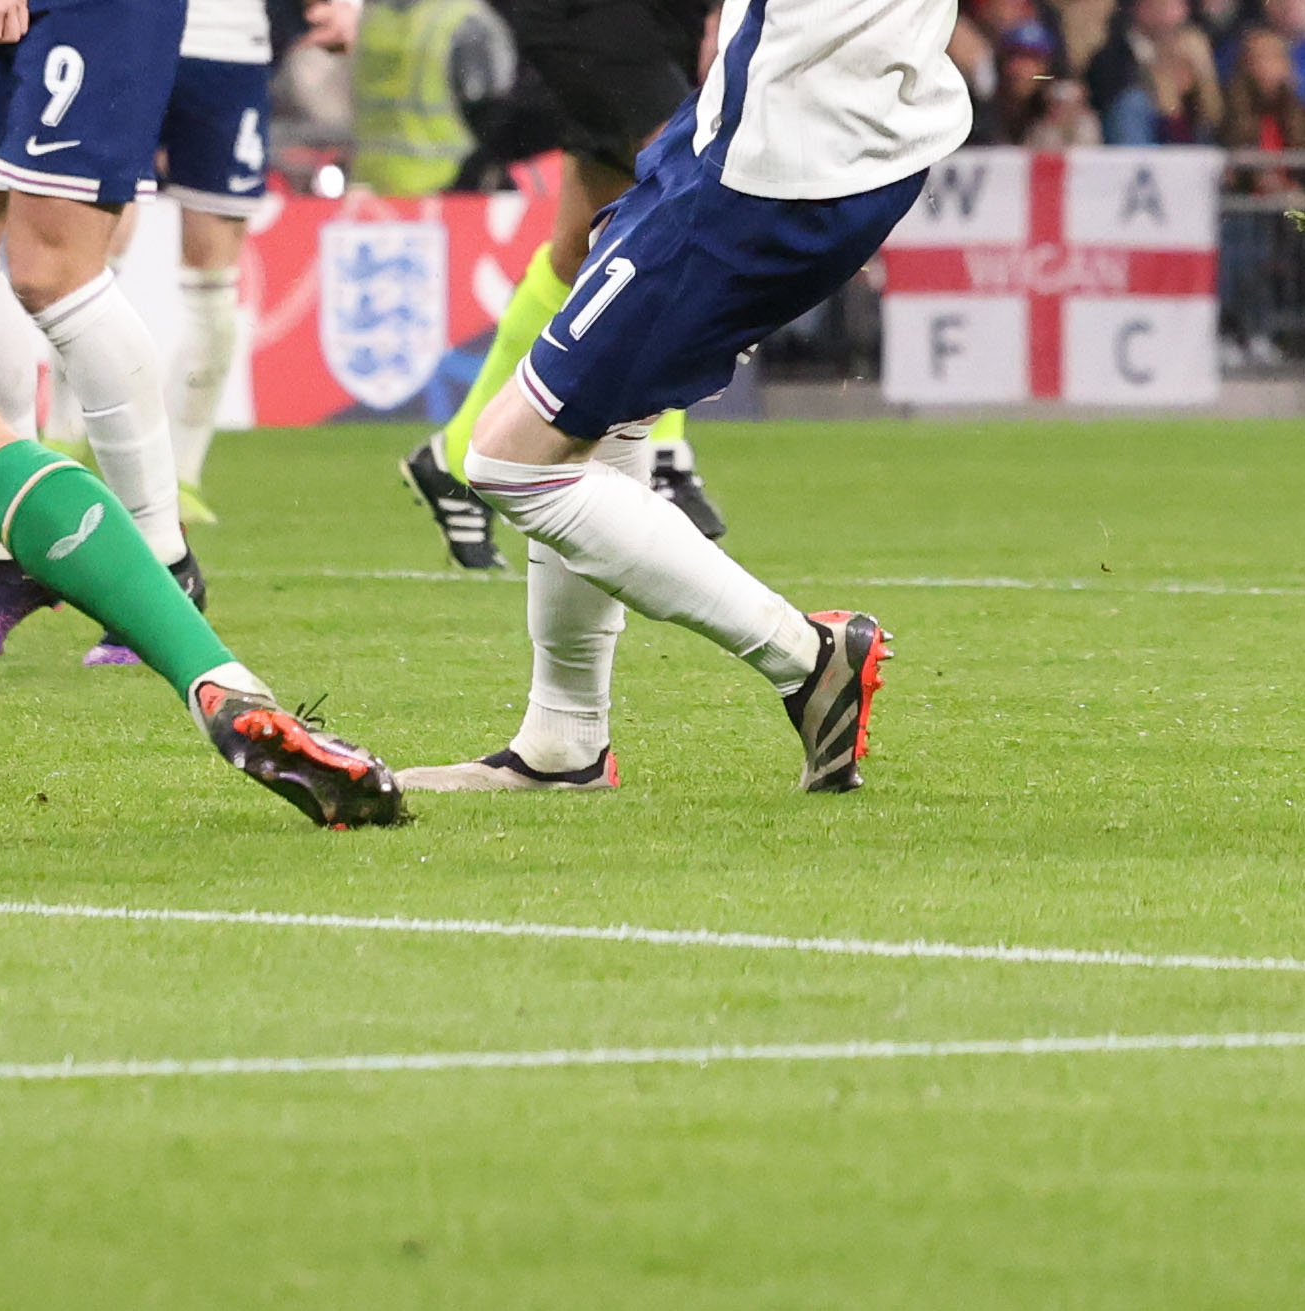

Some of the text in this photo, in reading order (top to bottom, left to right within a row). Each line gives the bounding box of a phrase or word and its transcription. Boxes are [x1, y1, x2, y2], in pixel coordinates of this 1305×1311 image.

[41, 45, 85, 128] 9
[234, 107, 265, 171] 4
[924, 162, 1167, 225] W A
[963, 240, 1130, 295] WIGAN
[928, 312, 1155, 386] F C
